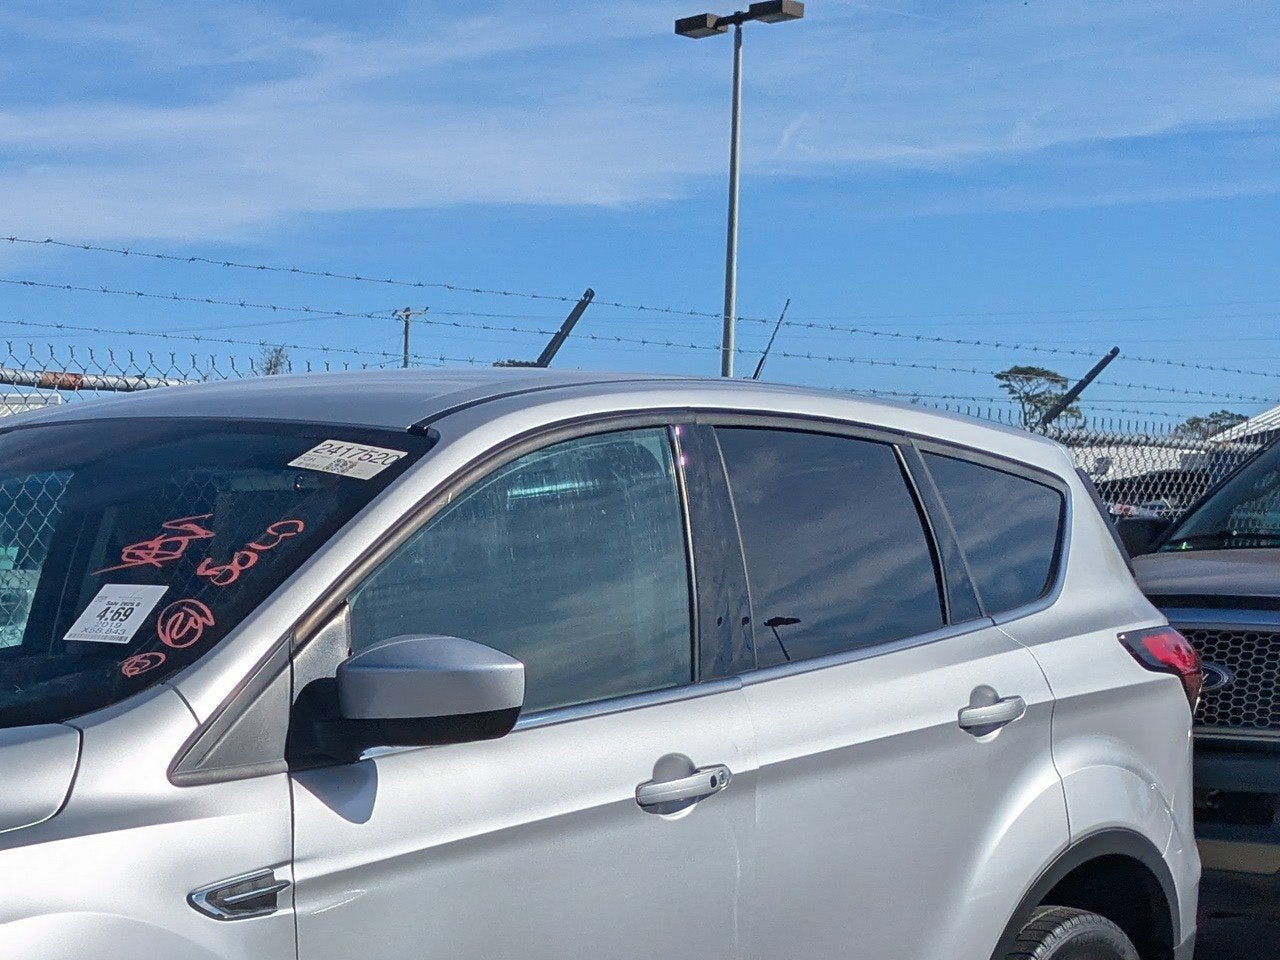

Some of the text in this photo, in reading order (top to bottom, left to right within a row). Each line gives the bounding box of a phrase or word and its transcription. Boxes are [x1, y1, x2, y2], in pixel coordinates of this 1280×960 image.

[312, 443, 401, 466] 2417520
[96, 606, 135, 622] 4:69
[94, 621, 123, 629] 2019
